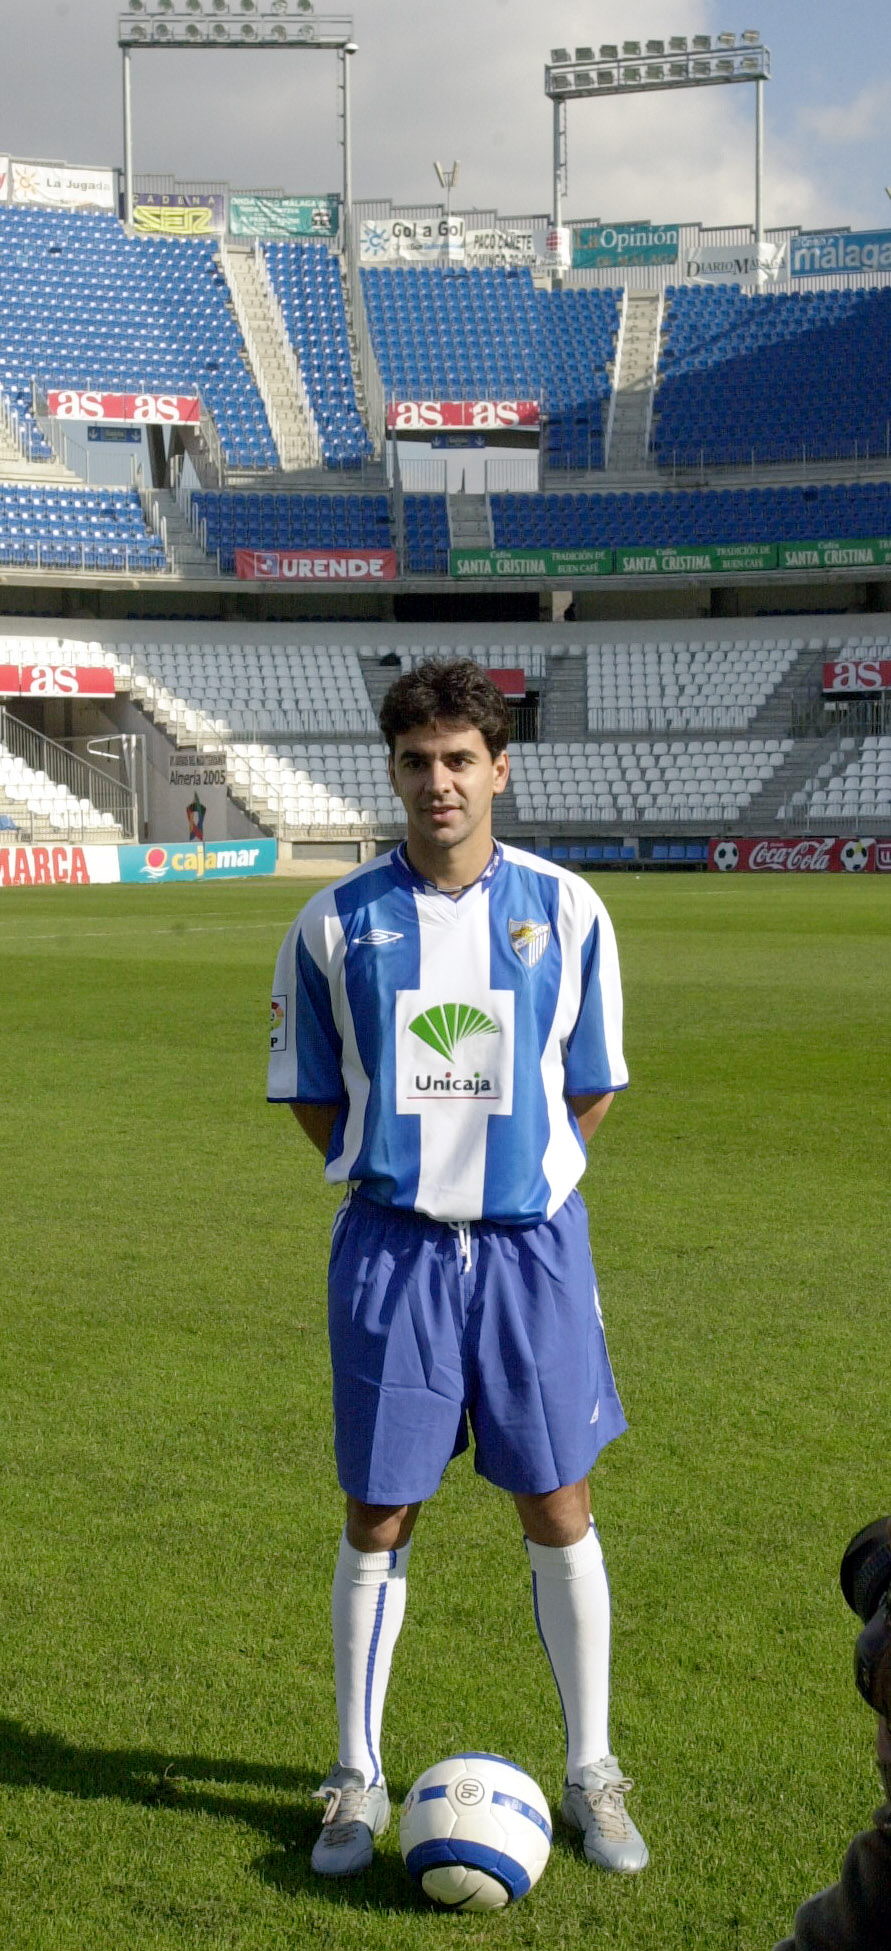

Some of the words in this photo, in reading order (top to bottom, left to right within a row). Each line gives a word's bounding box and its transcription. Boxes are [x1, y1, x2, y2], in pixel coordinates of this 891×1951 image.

[46, 178, 61, 188] La
[66, 180, 111, 191] Jugada
[392, 222, 417, 238] Gol
[423, 226, 432, 238] a
[438, 221, 463, 237] Gol
[474, 234, 496, 249] PACO
[600, 226, 678, 252] Opinión
[686, 261, 733, 277] DIARIO
[56, 391, 104, 419] as
[134, 395, 180, 423] as
[396, 401, 443, 428] as
[473, 401, 520, 428] as
[623, 557, 657, 572] SANTA
[662, 555, 712, 570] CRISTINA
[785, 551, 819, 566] SANTA
[824, 548, 874, 564] CRISTINA
[282, 559, 383, 577] URENDE
[457, 559, 491, 574] SANTA
[496, 559, 546, 574] CRISTINA
[30, 665, 79, 694] as
[832, 661, 883, 689] as
[203, 769, 226, 785] 2005
[171, 845, 260, 877] cajamar
[415, 1072, 492, 1095] Unicaja
